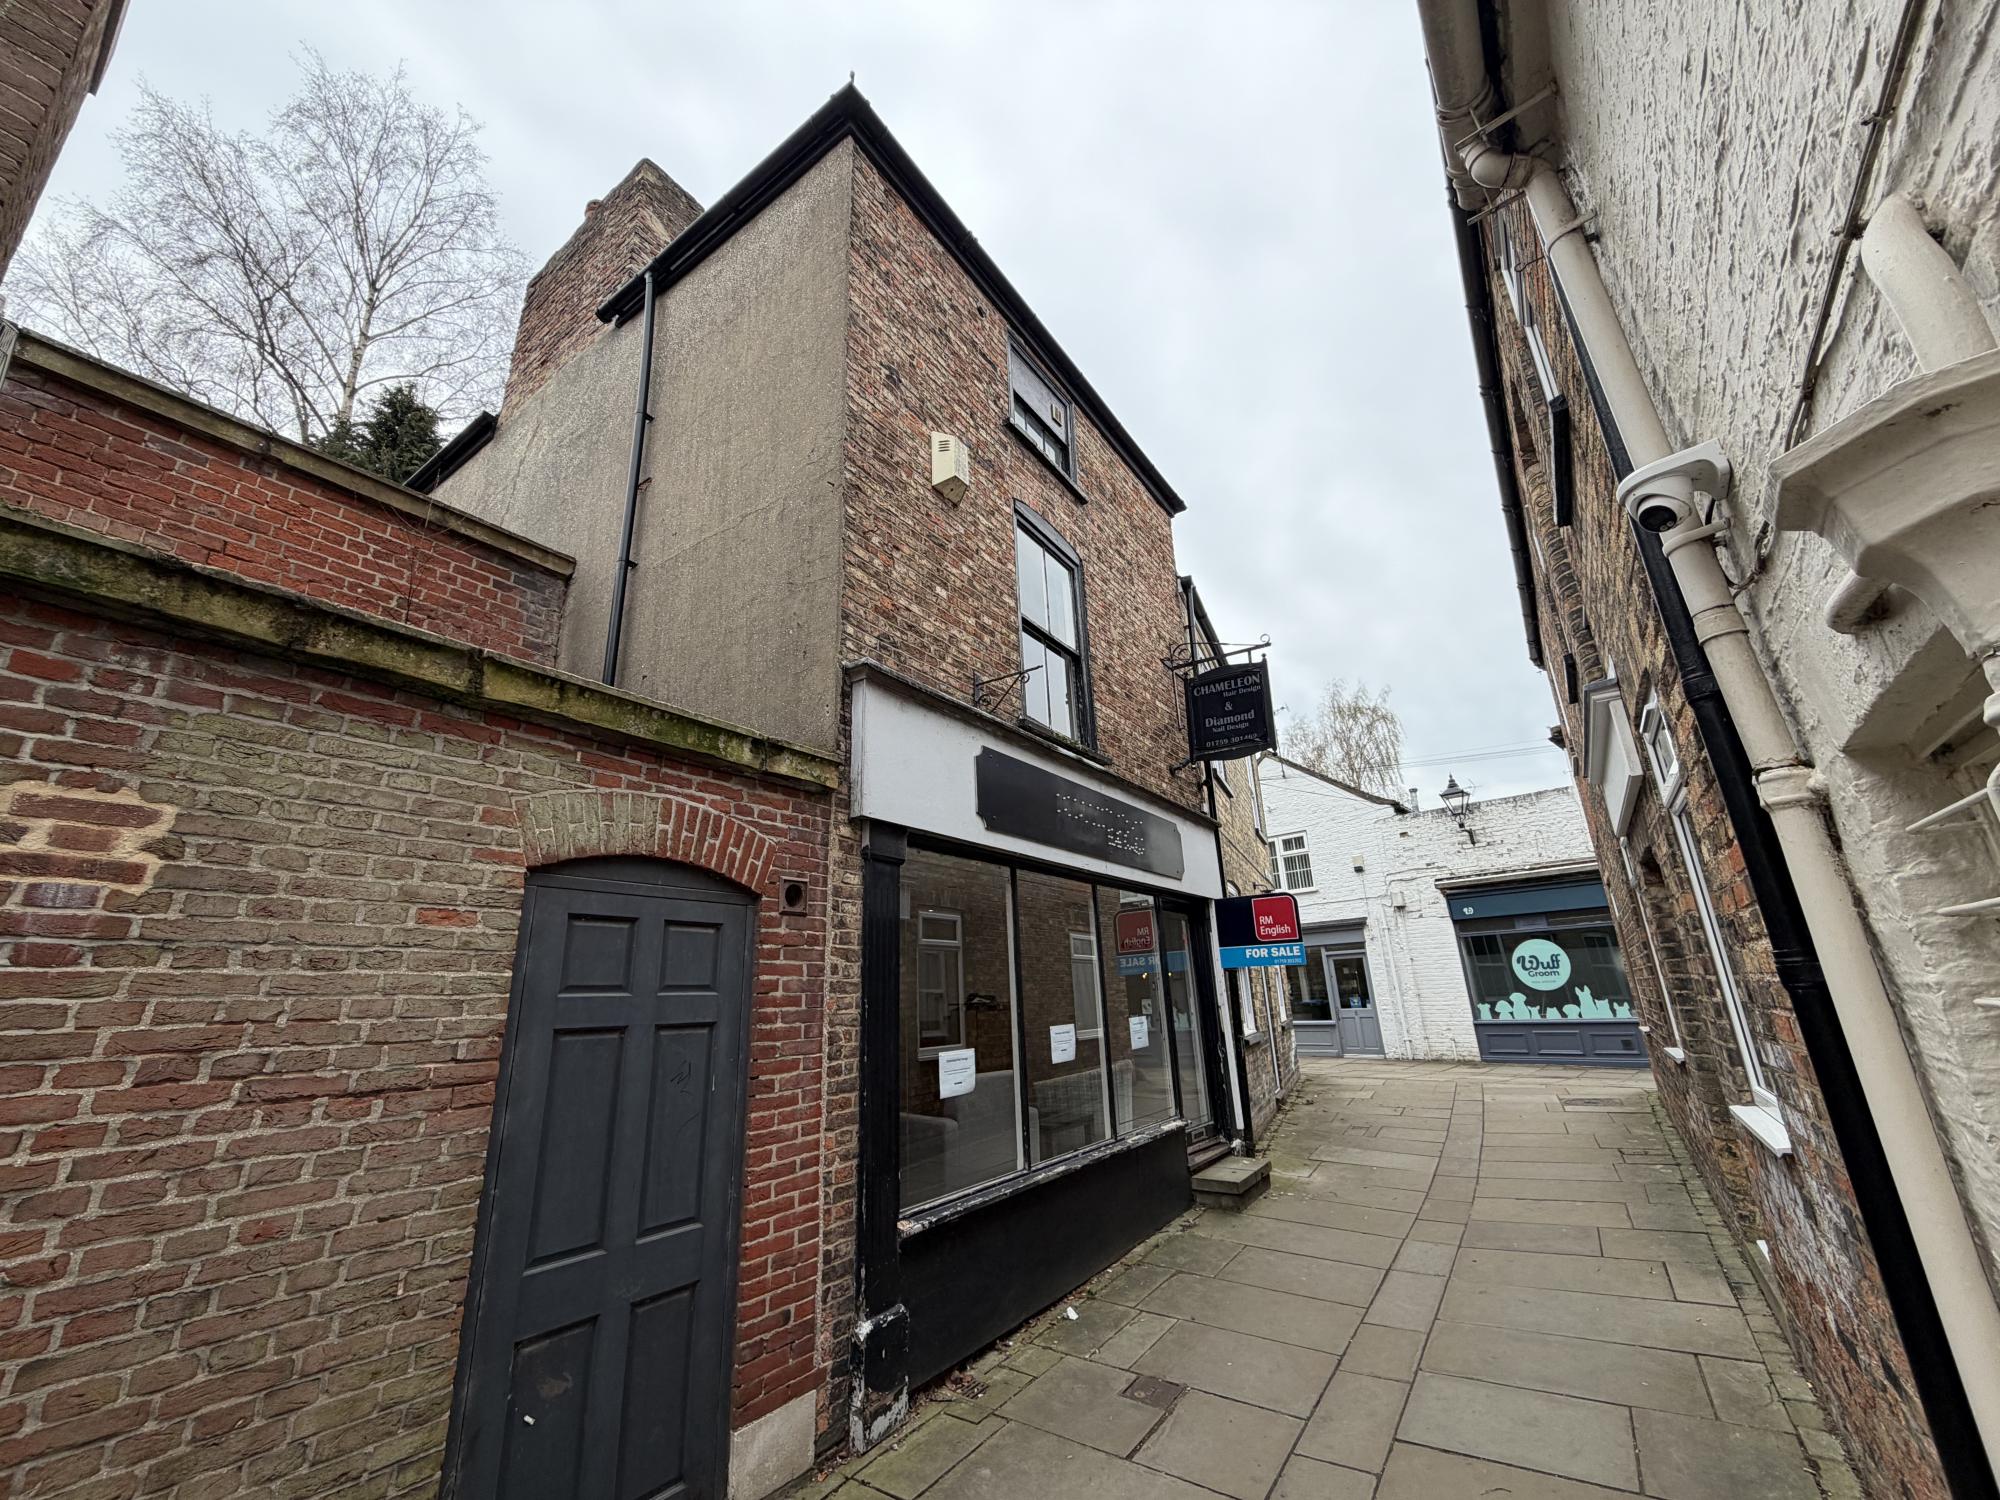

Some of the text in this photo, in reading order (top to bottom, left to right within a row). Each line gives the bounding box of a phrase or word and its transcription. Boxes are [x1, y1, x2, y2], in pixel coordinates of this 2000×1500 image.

[1193, 673, 1261, 697] CHAMELEON
[1223, 685, 1261, 697] Hair Design
[1224, 701, 1233, 711] &
[1205, 709, 1255, 728] Diamond
[1212, 721, 1249, 733] Nail Design
[1206, 738, 1229, 748] 01759
[1259, 915, 1274, 925] RM
[1260, 924, 1291, 937] English
[1245, 946, 1301, 958] FOR SALE
[1516, 953, 1561, 971] Wuff
